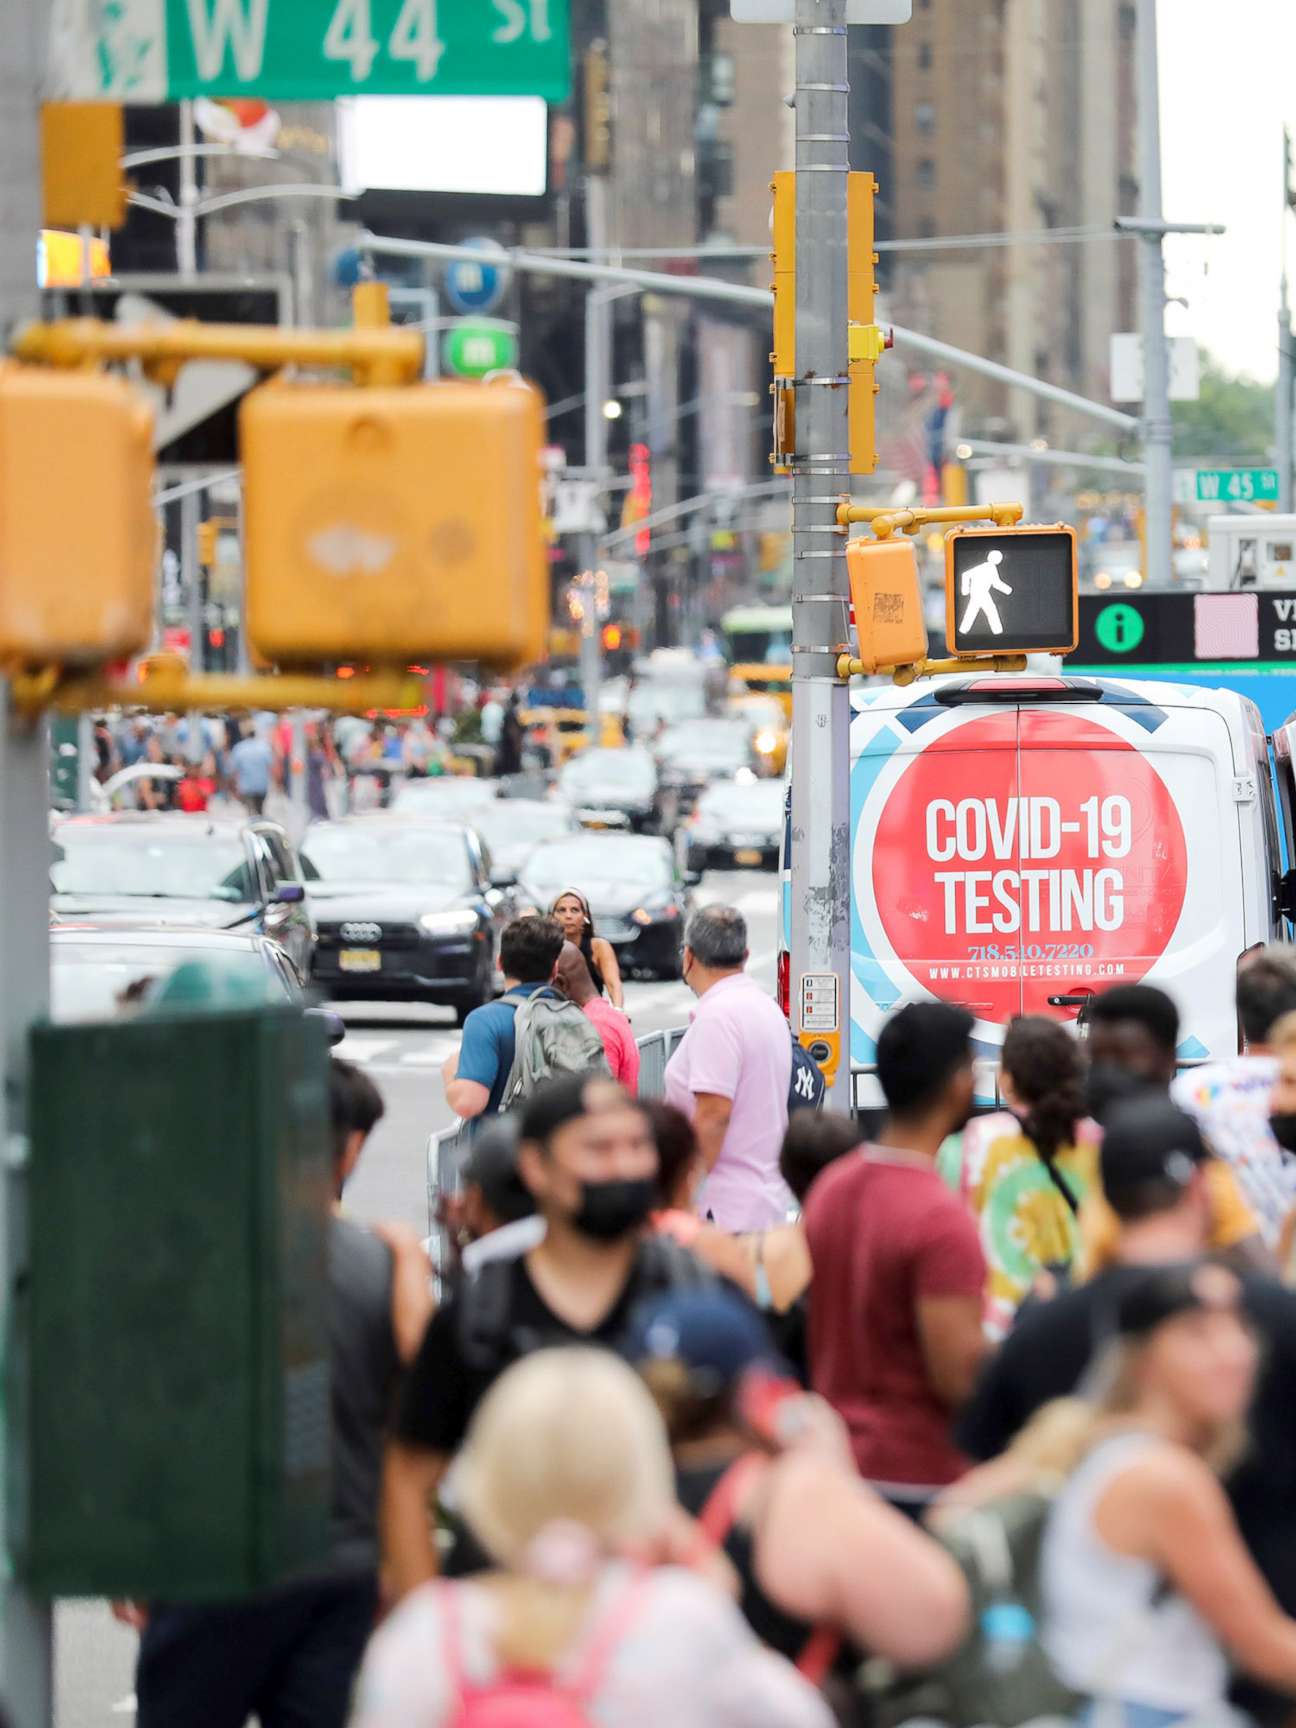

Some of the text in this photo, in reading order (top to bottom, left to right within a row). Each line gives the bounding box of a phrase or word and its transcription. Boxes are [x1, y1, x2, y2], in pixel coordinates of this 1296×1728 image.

[186, 0, 270, 83] W
[323, 0, 446, 83] 44
[1199, 474, 1220, 499] W
[1227, 472, 1254, 500] 45
[925, 795, 1131, 862] COVID-19
[934, 868, 1125, 934] TESTING
[794, 1065, 815, 1101] NY
